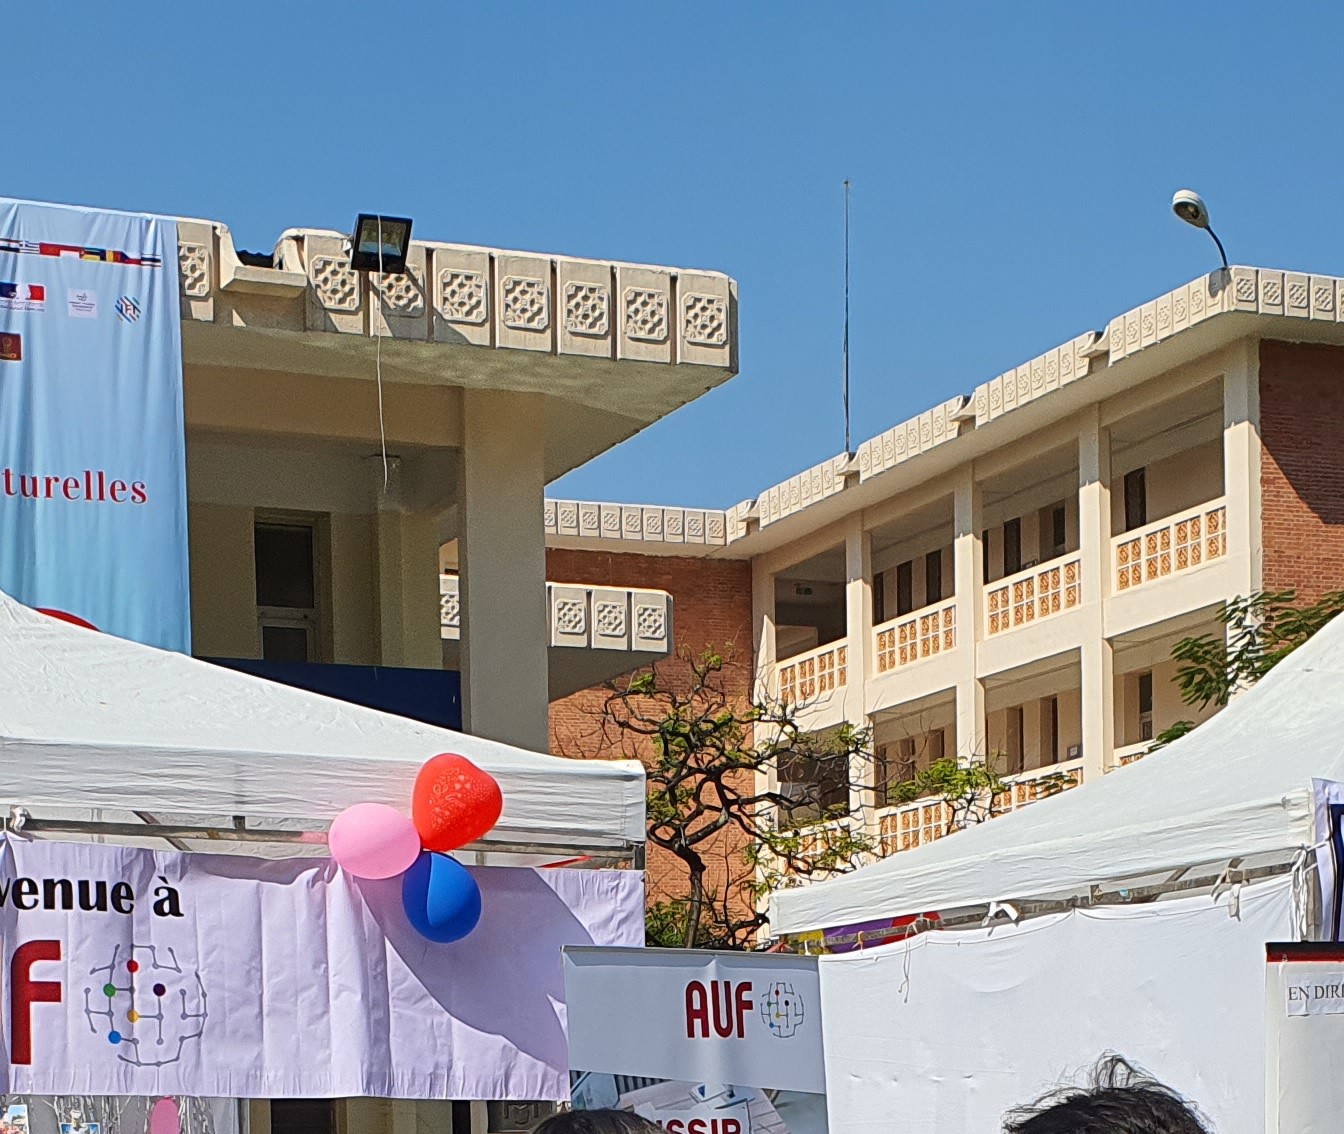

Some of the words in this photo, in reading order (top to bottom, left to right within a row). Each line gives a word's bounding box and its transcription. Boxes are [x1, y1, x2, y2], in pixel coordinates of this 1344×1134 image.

[153, 876, 185, 917] à
[685, 980, 753, 1038] AUF
[1288, 986, 1309, 1000] EN
